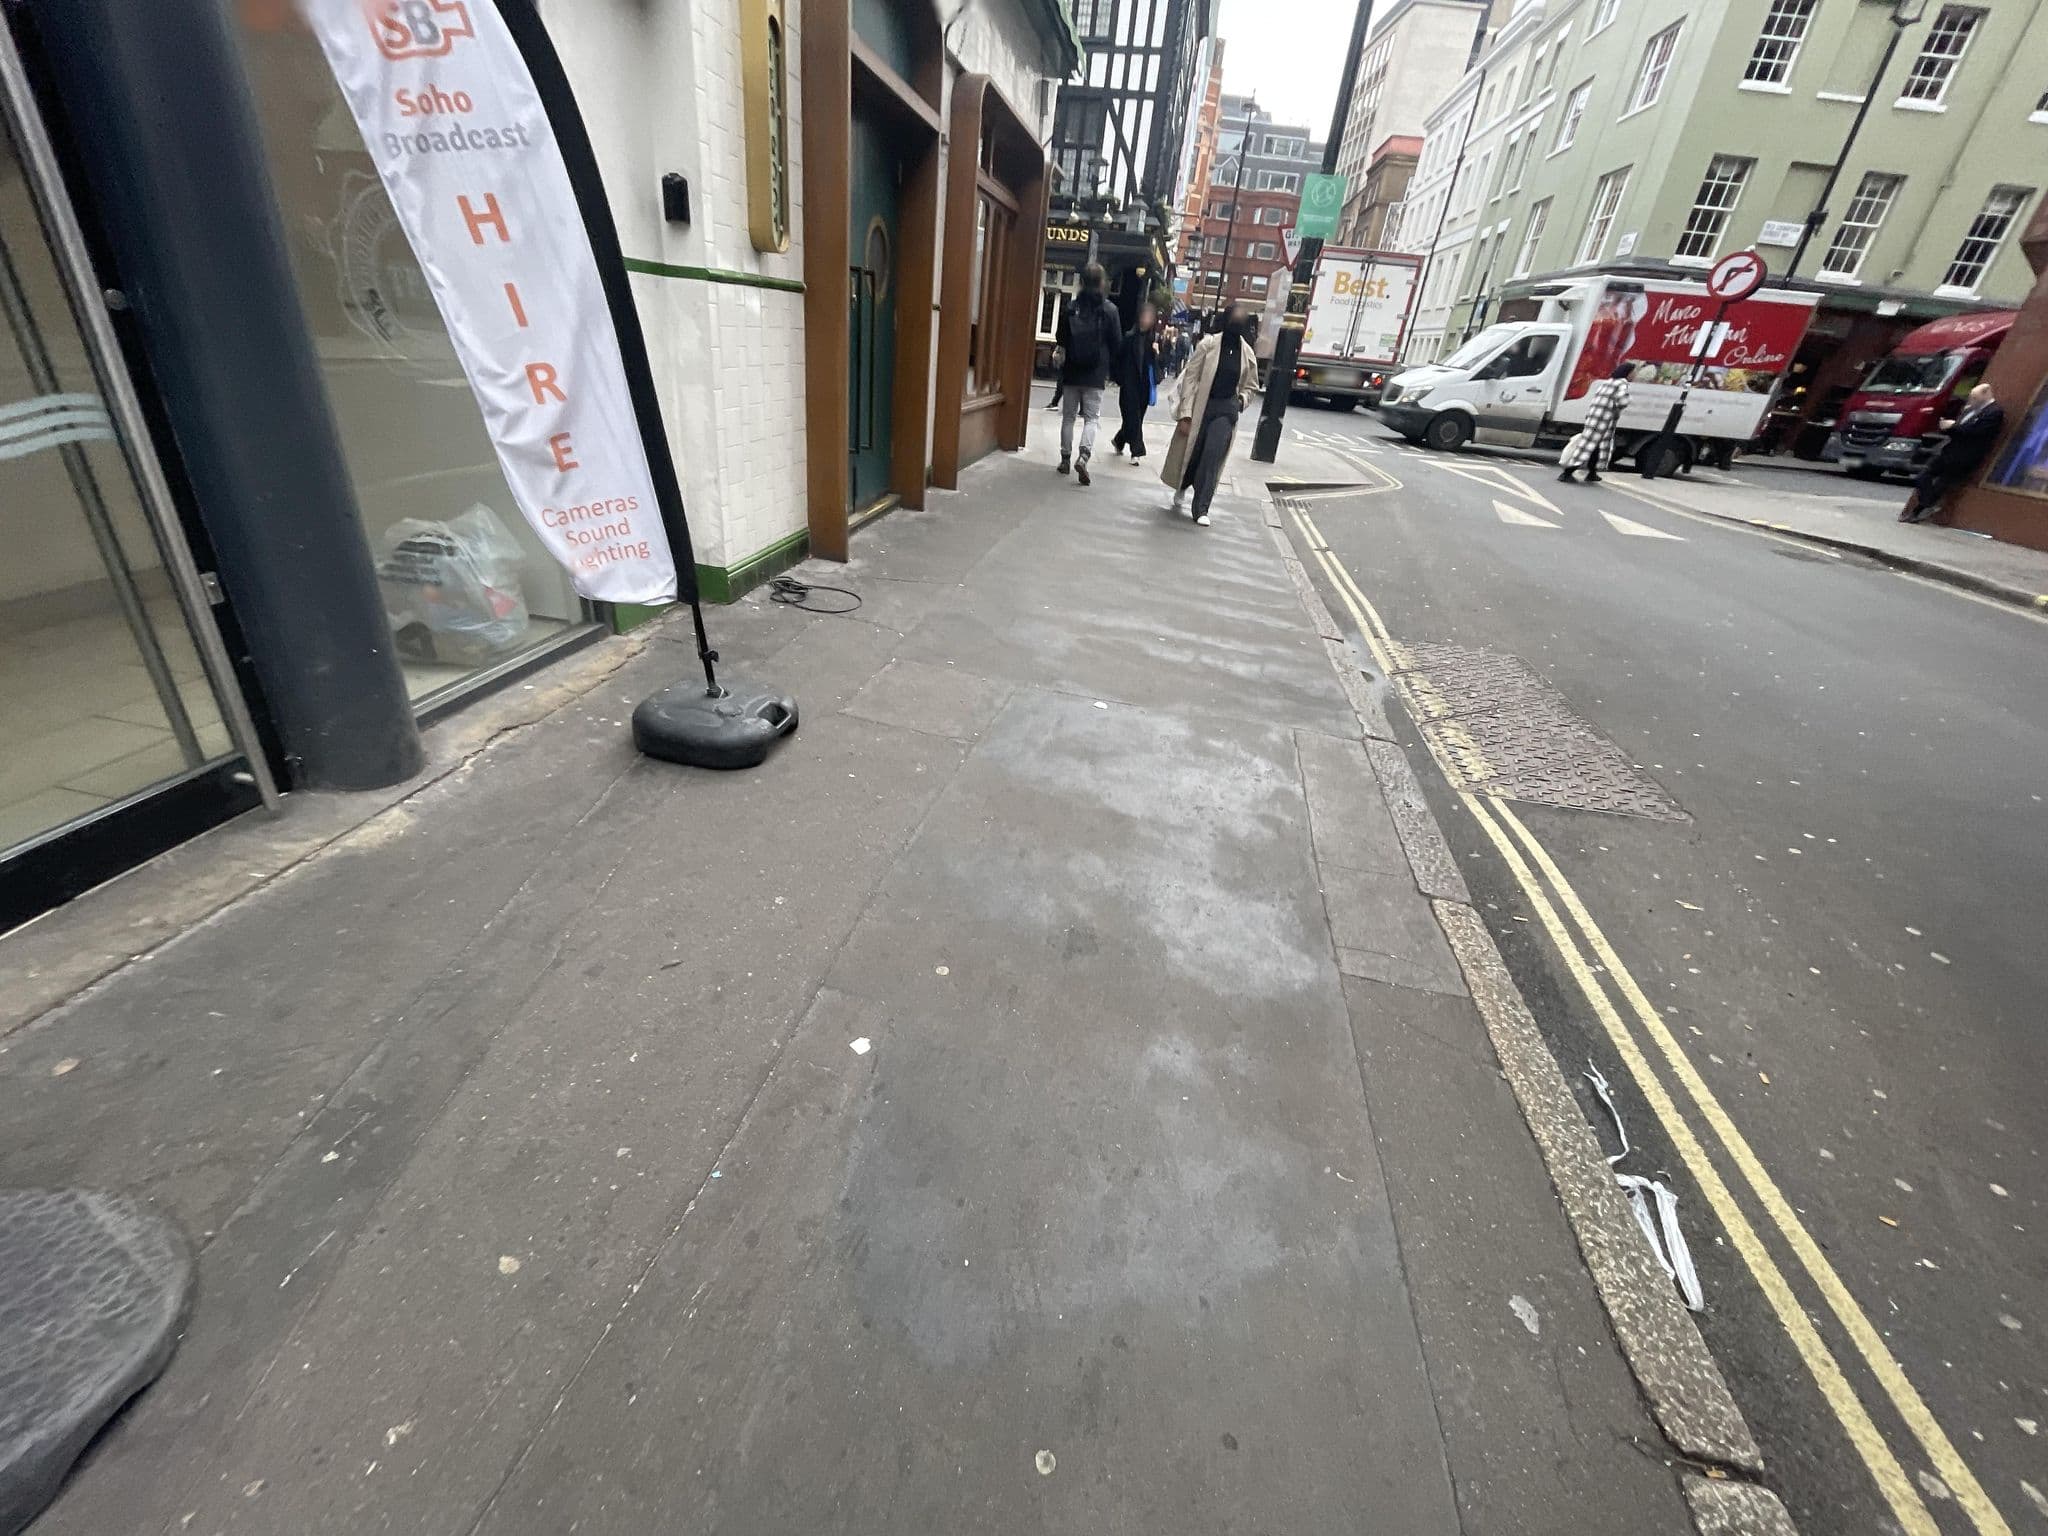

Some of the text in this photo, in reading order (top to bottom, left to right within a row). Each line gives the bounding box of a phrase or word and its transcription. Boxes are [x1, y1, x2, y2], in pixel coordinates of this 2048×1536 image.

[395, 83, 473, 117] Soho
[383, 121, 531, 158] Broadcast
[1723, 344, 1785, 366] Online
[541, 496, 639, 528] Cameras
[565, 517, 631, 546] Sound
[573, 541, 650, 571] ighting
